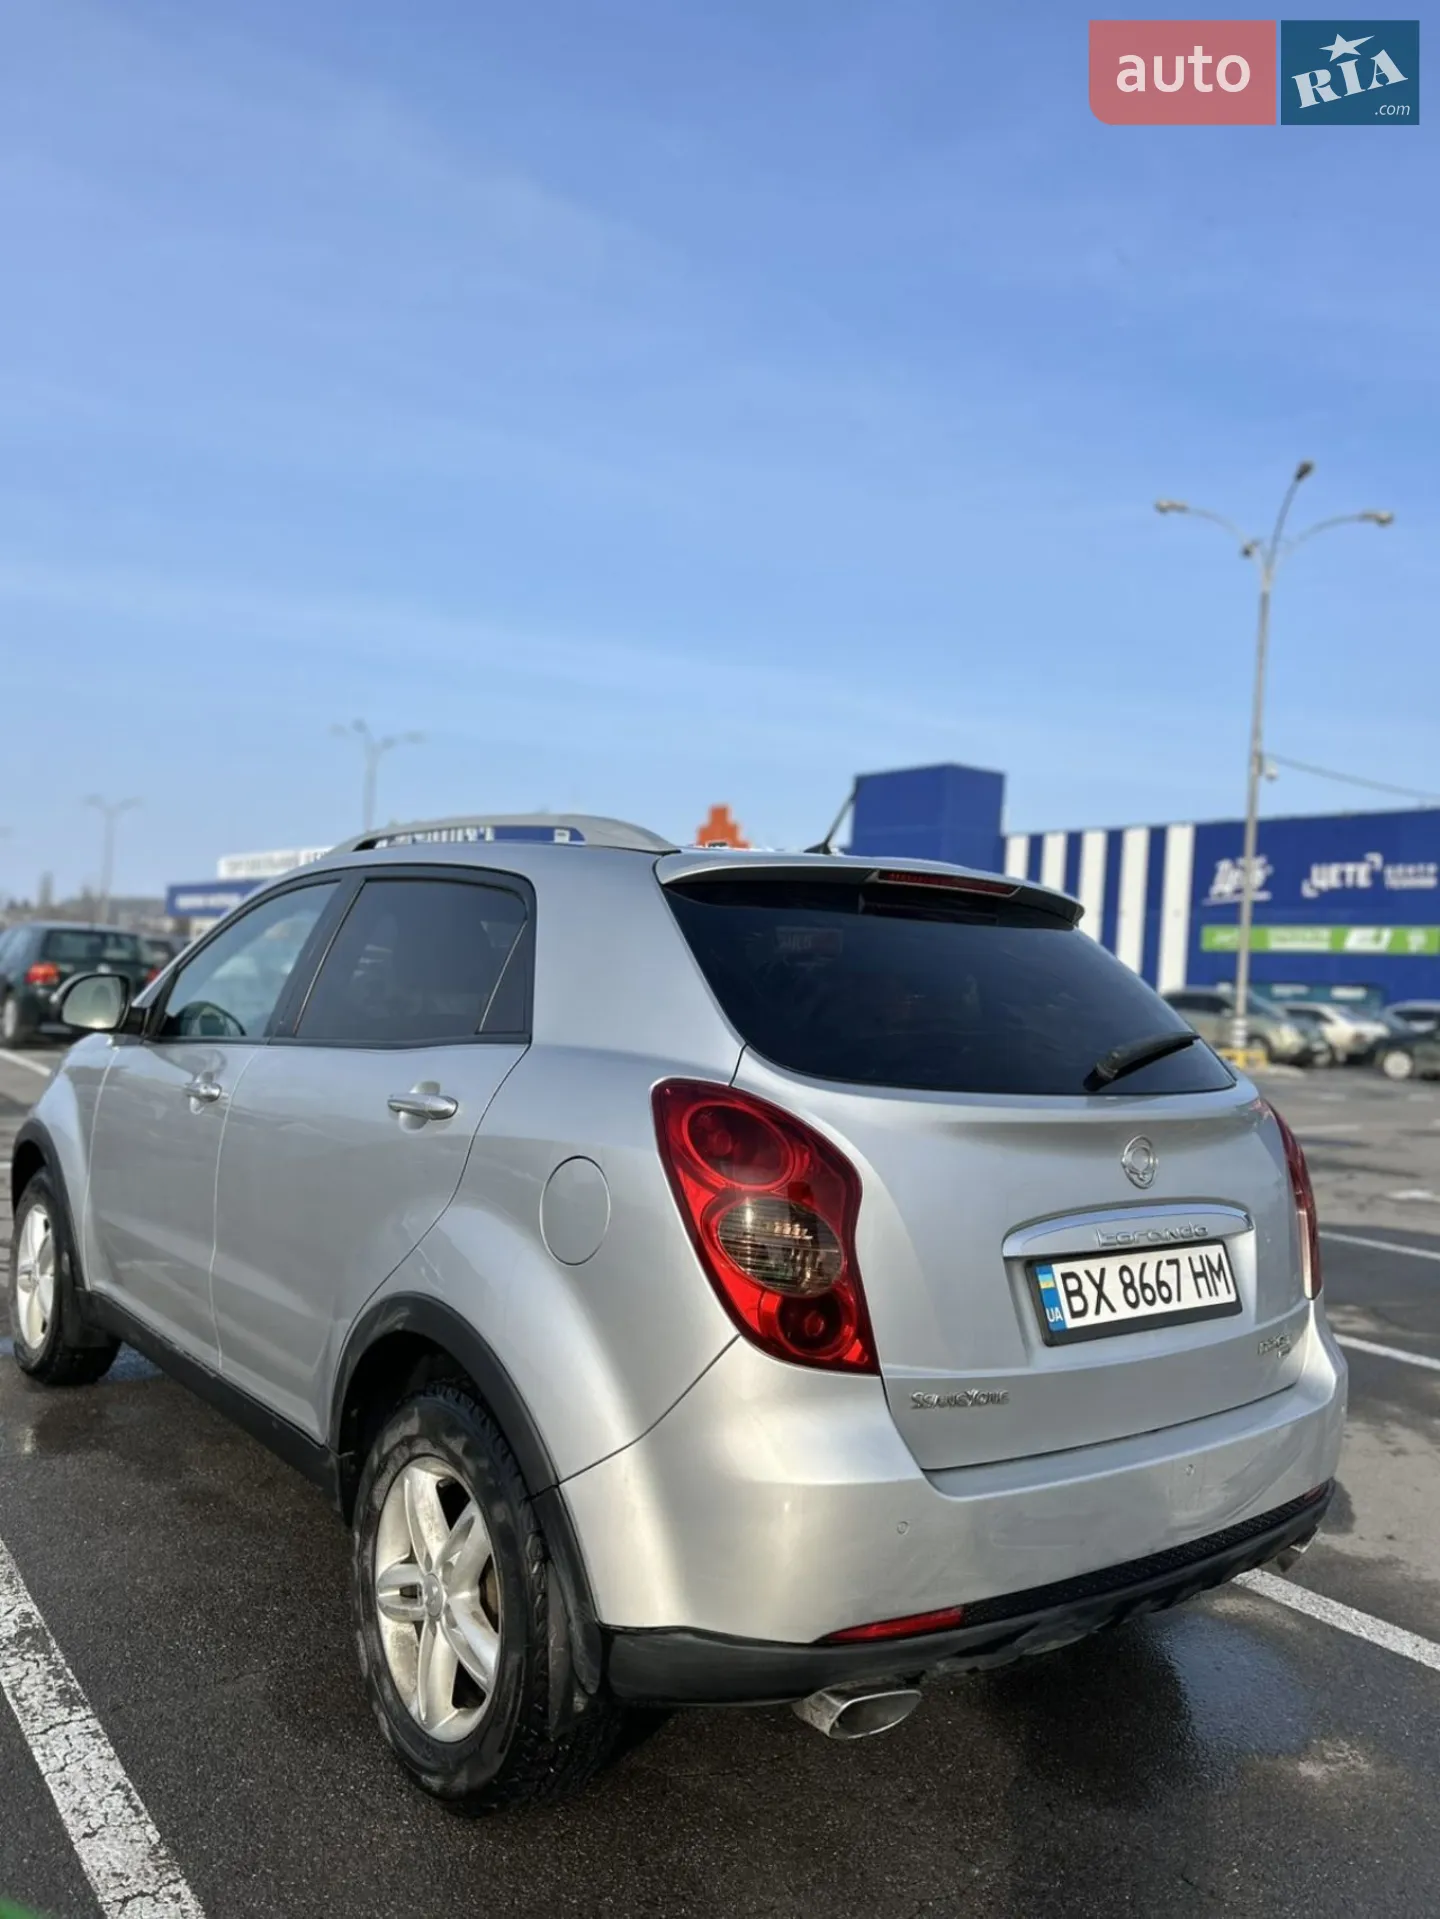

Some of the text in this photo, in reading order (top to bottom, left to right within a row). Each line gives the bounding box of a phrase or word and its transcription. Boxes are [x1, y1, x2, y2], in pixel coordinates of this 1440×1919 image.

[1060, 1252, 1232, 1319] BX 8667 HM
[1046, 1306, 1064, 1323] UA
